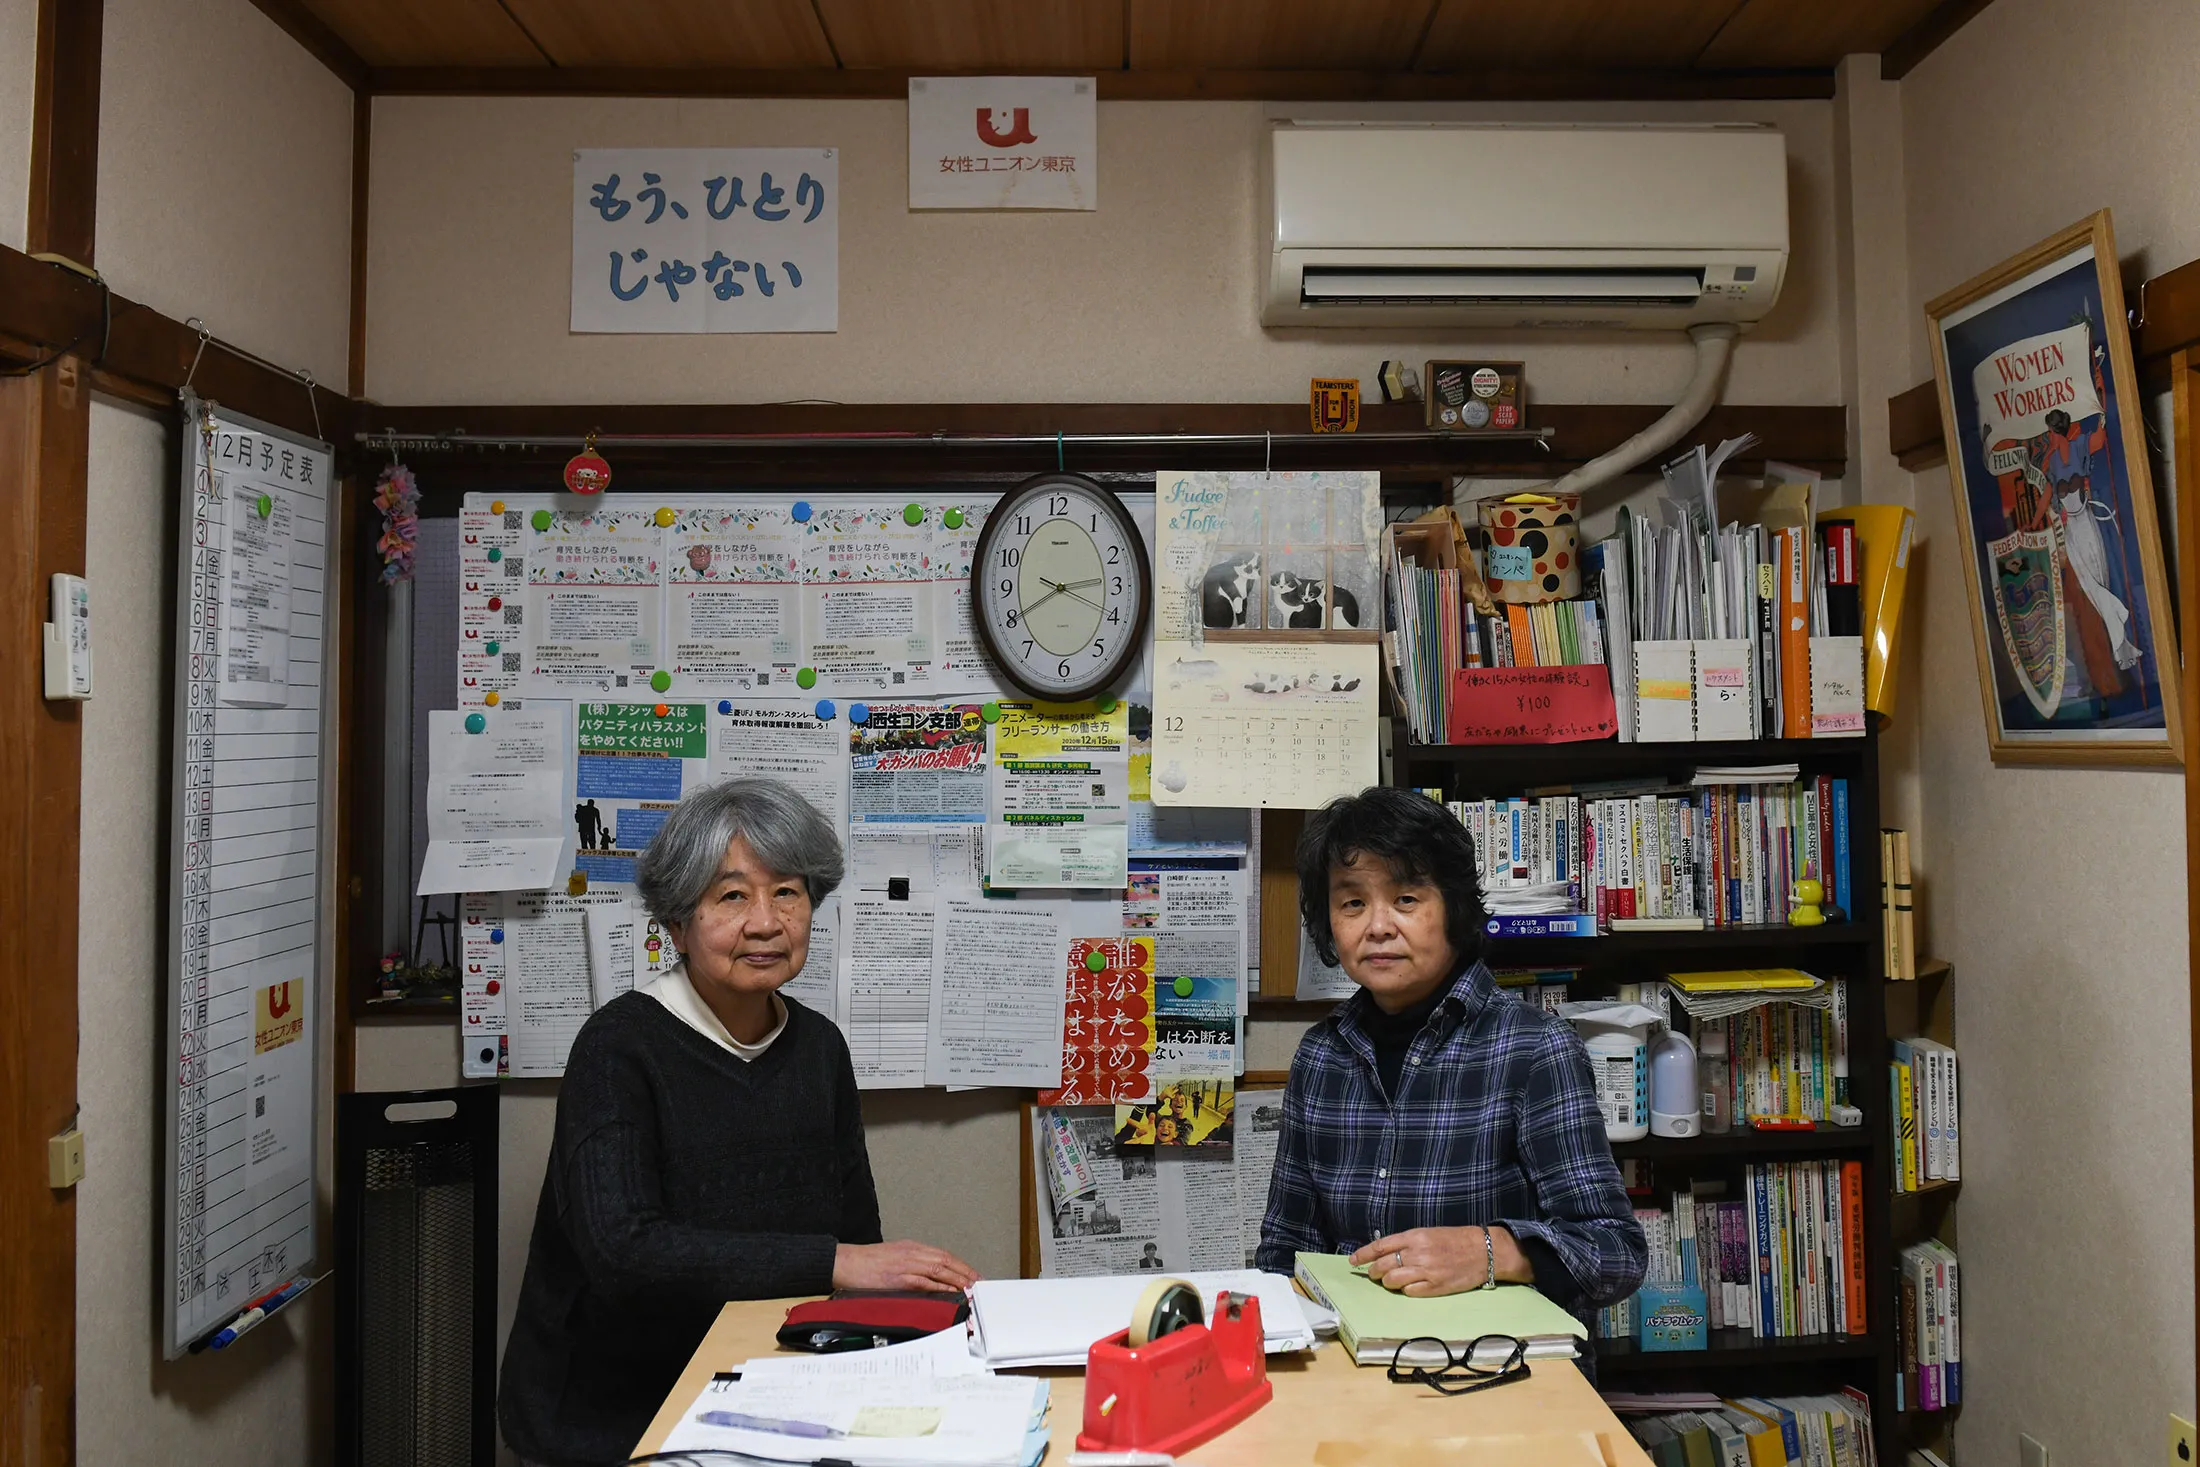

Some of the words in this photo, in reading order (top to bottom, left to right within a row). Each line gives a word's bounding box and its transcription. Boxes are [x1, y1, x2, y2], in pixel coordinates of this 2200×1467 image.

[939, 155, 1076, 174] 女性ユニオン東京
[590, 172, 825, 223] もう、ひとり
[609, 249, 803, 302] じゃない
[1994, 342, 2065, 384] WOMEN
[1315, 381, 1354, 390] TEAMSTERS
[1993, 376, 2076, 420] WORKERS
[214, 432, 315, 487] 12月予定表
[1165, 478, 1224, 505] Fudge
[198, 497, 205, 517] 2
[1048, 496, 1069, 516] 12
[1015, 516, 1032, 536] 11
[1090, 514, 1097, 533] 1
[1169, 518, 1179, 530] &
[1179, 508, 1228, 532] Toffee
[197, 523, 205, 543] 3
[556, 546, 618, 554] 育児をしながら
[828, 543, 890, 552] 育児をしながら
[1107, 545, 1120, 565] 2
[1992, 534, 2038, 556] FEDERATION
[2040, 535, 2048, 547] OF
[195, 550, 204, 570] 4
[208, 554, 218, 575] 金
[1000, 548, 1020, 568] 10
[1491, 564, 1525, 576] カンパ
[1762, 564, 1771, 595] セクハラ
[2051, 550, 2063, 611] WOMEN
[194, 576, 202, 595] 5
[207, 582, 216, 599] 土
[1000, 579, 1013, 599] 9
[1111, 576, 1122, 596] 3
[193, 604, 202, 623] 6
[206, 607, 215, 626] 日
[1006, 609, 1018, 629] 8
[1106, 606, 1120, 626] 4
[193, 631, 201, 651] 7
[205, 631, 215, 650] 月
[1021, 640, 1034, 659] 7
[1092, 638, 1105, 658] 5
[192, 659, 199, 677] 8
[204, 658, 214, 677] 火
[1057, 658, 1071, 678] 6
[191, 685, 199, 704] 9
[204, 685, 214, 704] 水
[1516, 694, 1551, 712] ¥100
[587, 703, 688, 716] （株）アシッスは
[189, 711, 199, 732] 10
[203, 712, 213, 731] 木
[857, 711, 962, 730] 関西生コン支部
[1001, 721, 1110, 738] フリーランサーの働き方
[1164, 717, 1184, 732] 12
[188, 739, 199, 759] 11
[202, 738, 213, 758] 金
[187, 766, 198, 785] 12
[202, 767, 211, 784] 土
[187, 794, 197, 813] 13
[202, 792, 210, 811] 日
[186, 821, 197, 840] 14
[201, 819, 210, 837] 月
[1498, 813, 1508, 861] 女の労働
[1520, 808, 1528, 862] フェミニズム法学
[1643, 800, 1659, 858] 職務格差
[1557, 819, 1565, 862] 日本女性史
[1618, 803, 1630, 886] マスコミ・セクハラ白書
[186, 846, 196, 867] 15
[200, 847, 210, 865] 火
[1682, 838, 1693, 876] 生活保護
[185, 874, 195, 894] 16
[199, 873, 209, 891] 水
[184, 900, 195, 920] 17
[199, 900, 208, 919] 木
[1512, 919, 1537, 928] ぬれマスク
[183, 927, 195, 948] 18
[198, 926, 208, 946] 金
[182, 955, 194, 976] 19
[198, 954, 207, 972] 土
[182, 983, 193, 1003] 20
[199, 978, 206, 997] 日
[182, 1007, 193, 1030] 21
[195, 1006, 207, 1026] 月
[1105, 938, 1137, 1105] 誰がために
[255, 1017, 304, 1049] 女性ユニオン東京
[181, 1035, 192, 1058] 22
[195, 1038, 206, 1051] 火
[180, 1062, 192, 1085] 23
[195, 1059, 206, 1079] 水
[180, 1090, 192, 1111] 24
[195, 1087, 206, 1103] 木
[180, 1117, 191, 1138] 25
[195, 1112, 205, 1131] 金
[180, 1143, 191, 1165] 26
[180, 1170, 191, 1192] 27
[195, 1165, 204, 1184] 日
[179, 1197, 191, 1219] 28
[194, 1191, 204, 1211] 月
[179, 1224, 191, 1247] 29
[194, 1219, 205, 1237] 火
[179, 1251, 191, 1274] 30
[194, 1246, 205, 1266] 水
[178, 1279, 191, 1301] 31
[193, 1274, 204, 1293] 木
